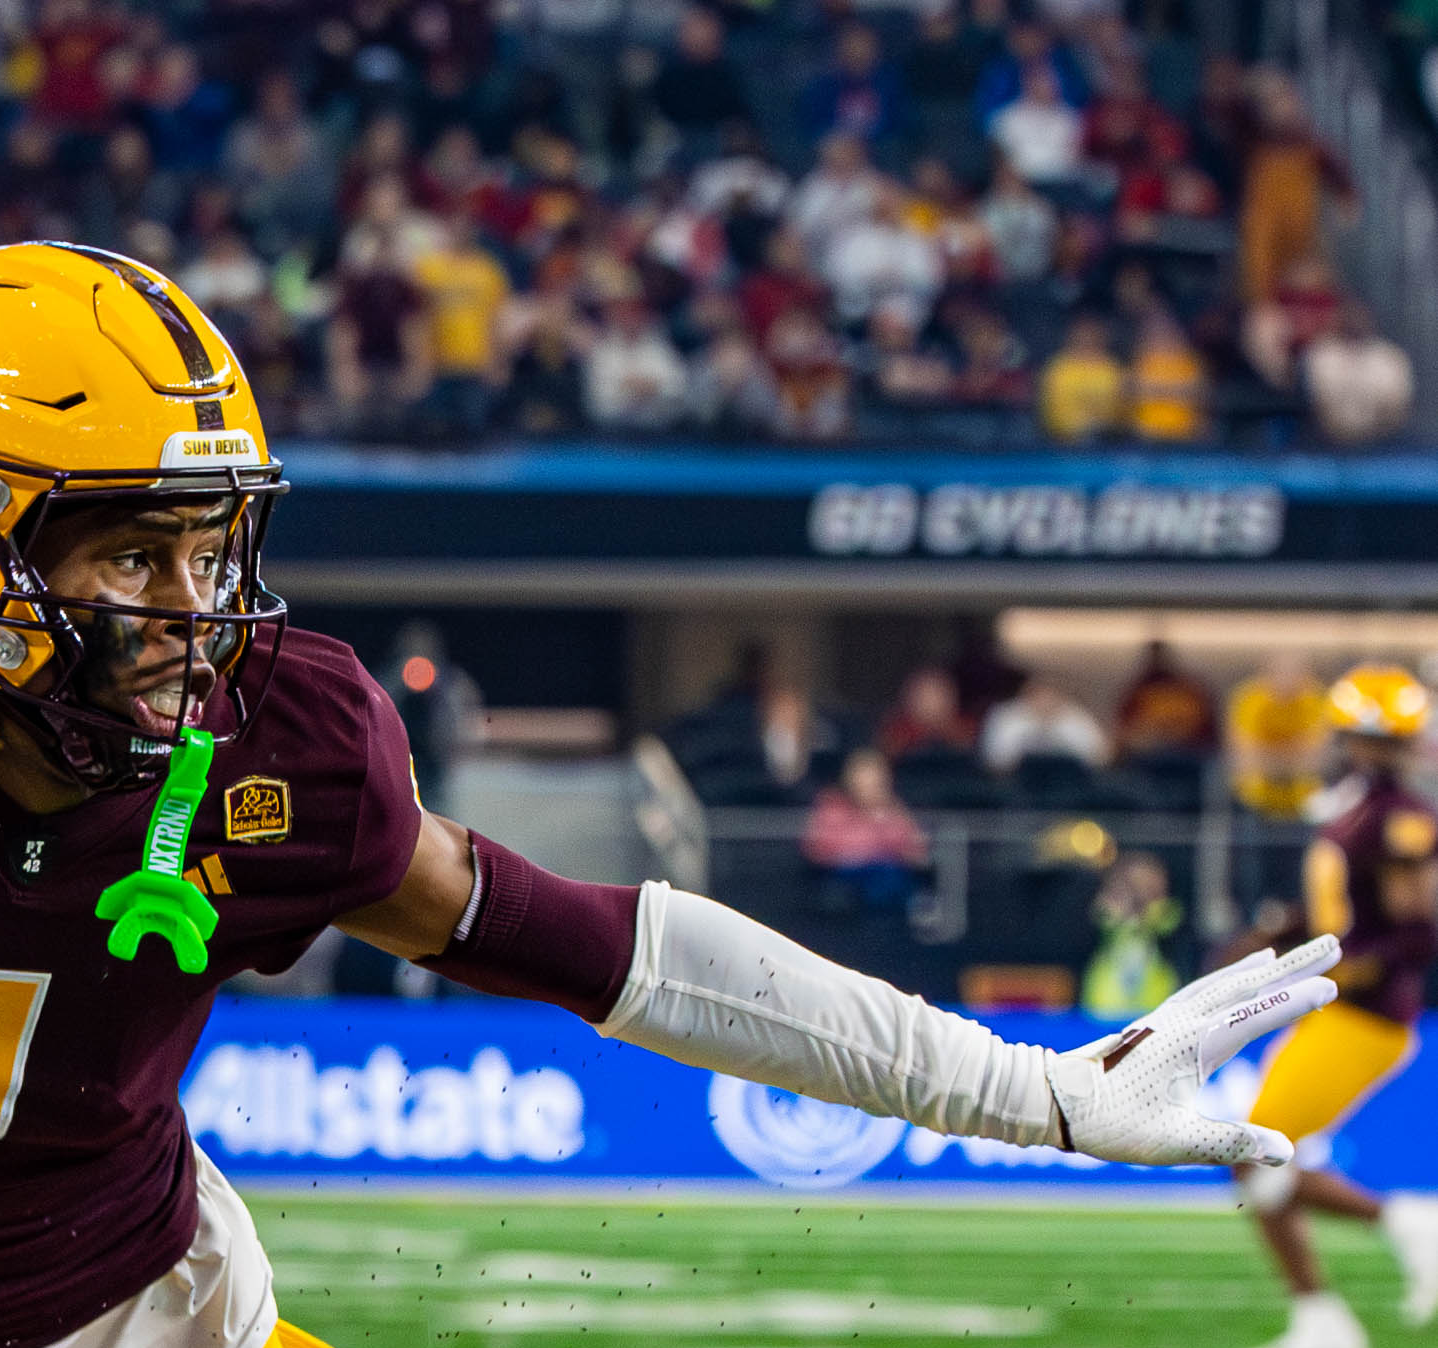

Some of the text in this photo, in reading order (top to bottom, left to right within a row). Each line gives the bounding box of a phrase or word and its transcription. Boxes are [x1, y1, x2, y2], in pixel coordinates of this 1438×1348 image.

[183, 438, 250, 456] SUN DEVILS
[1227, 990, 1291, 1030] ADIZERO
[182, 1043, 585, 1162] Allstate
